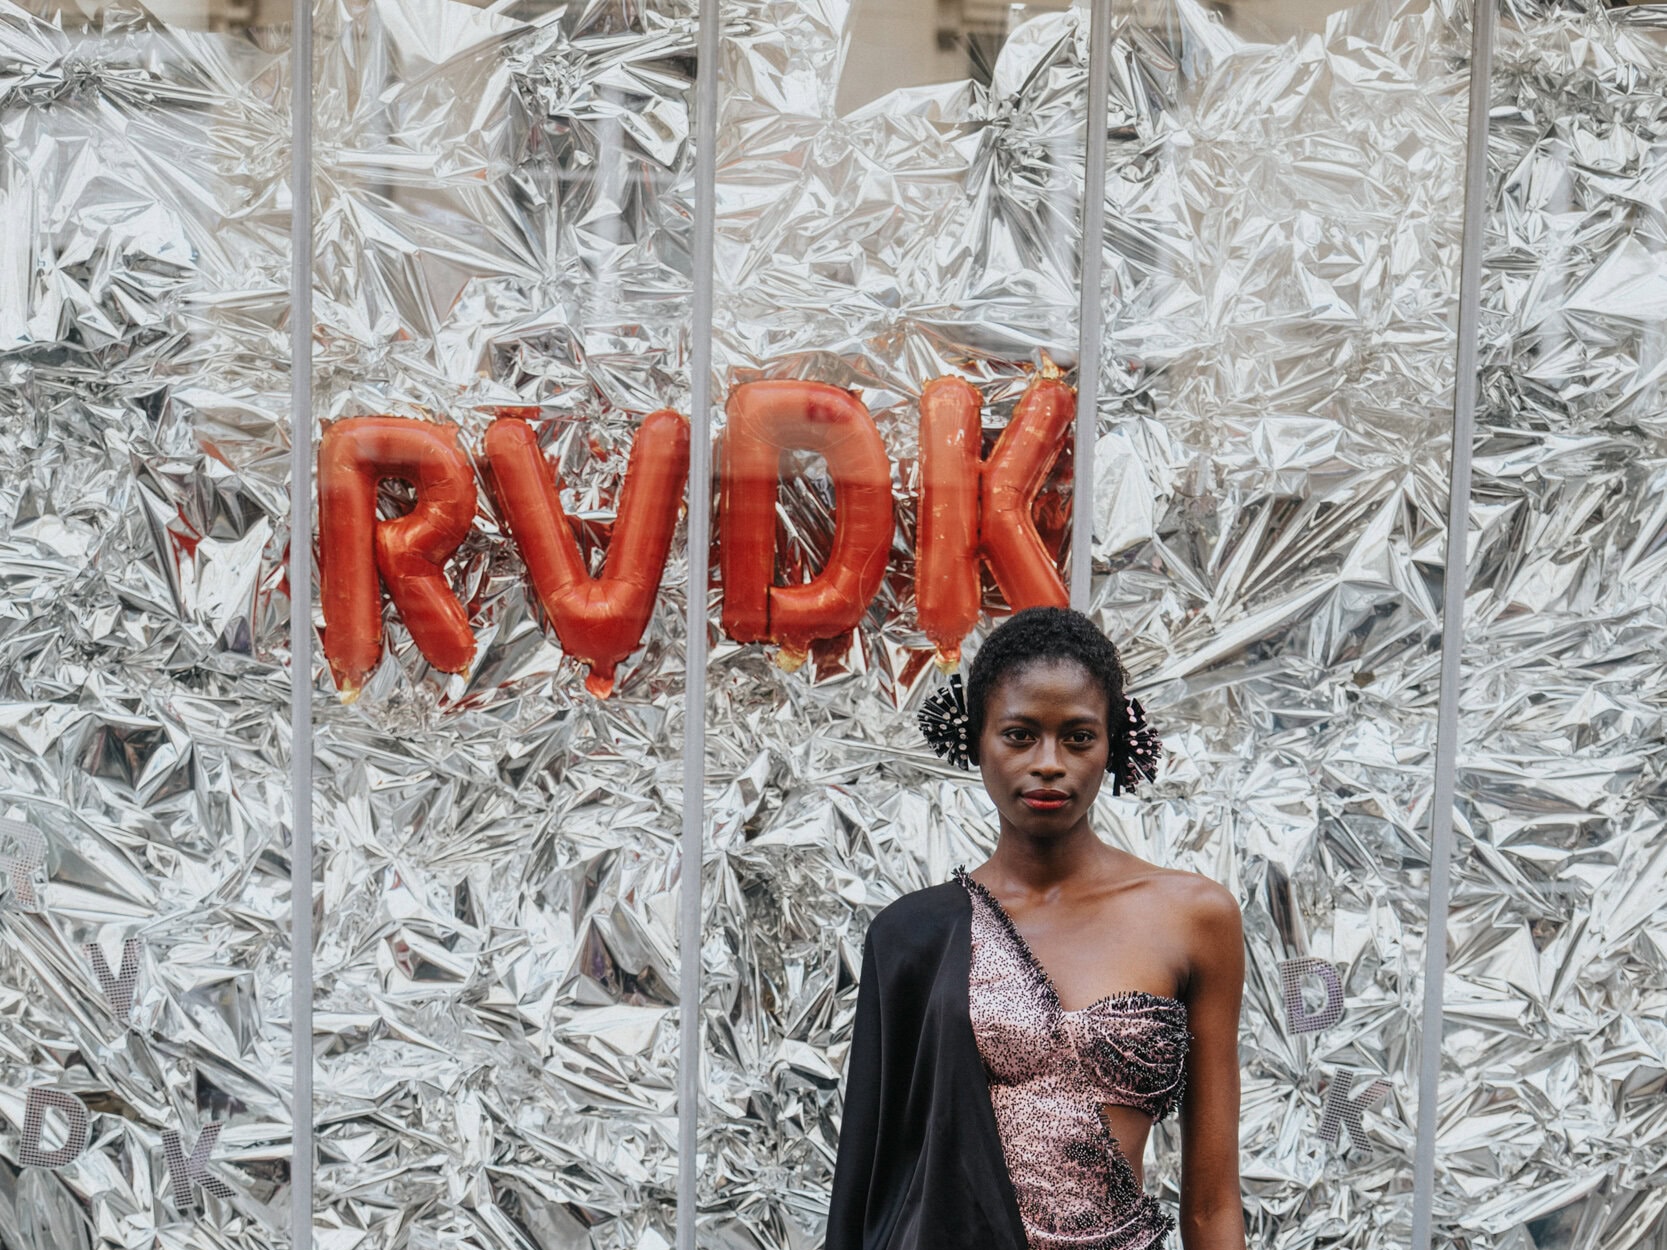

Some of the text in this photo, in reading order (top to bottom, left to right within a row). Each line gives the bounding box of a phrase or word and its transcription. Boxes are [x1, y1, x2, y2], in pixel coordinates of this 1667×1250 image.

[318, 374, 1077, 690] RVDK
[83, 937, 142, 1020] V
[18, 1086, 90, 1168] D
[161, 1121, 238, 1210] K
